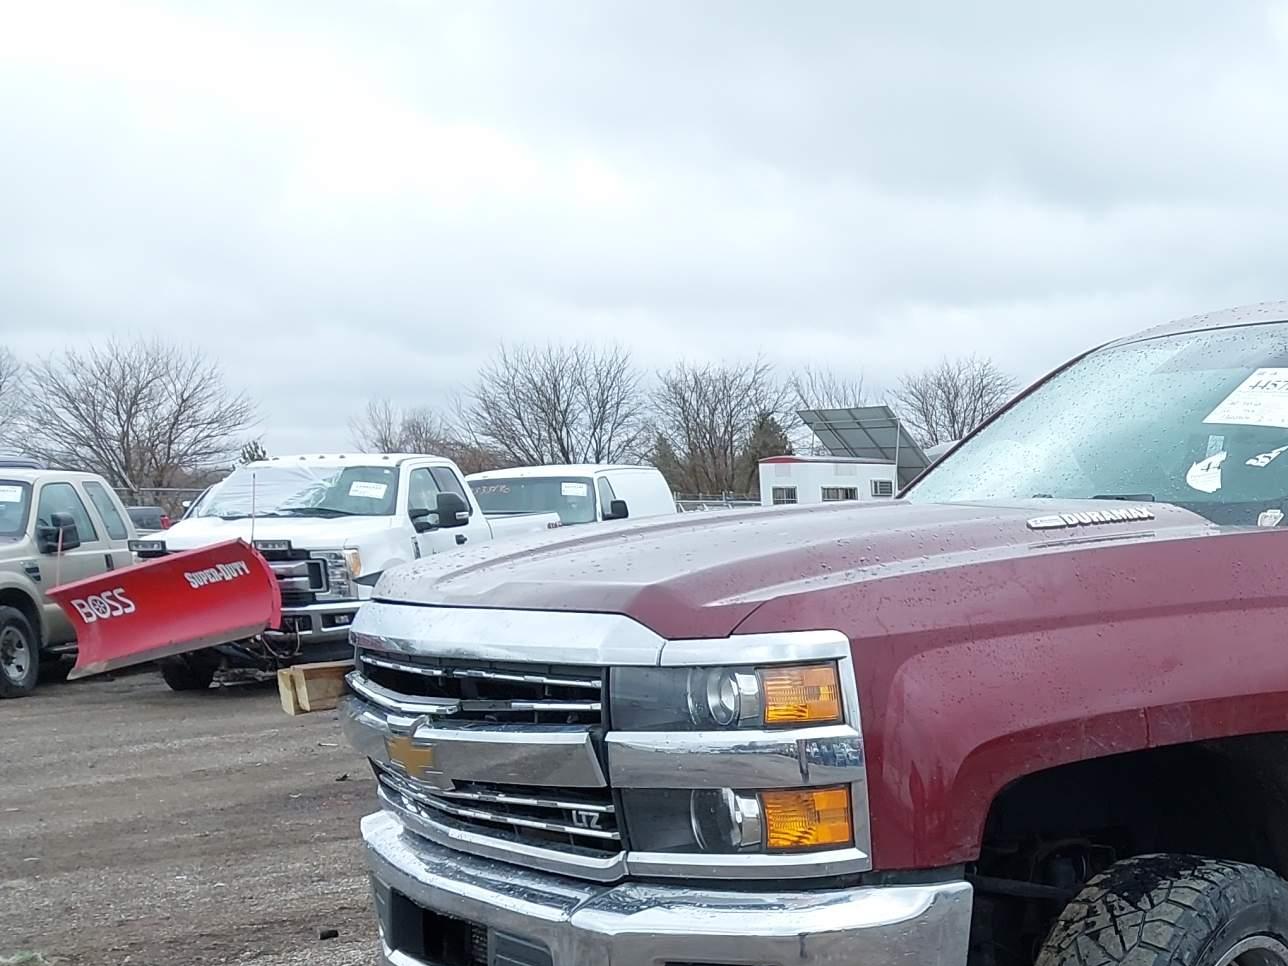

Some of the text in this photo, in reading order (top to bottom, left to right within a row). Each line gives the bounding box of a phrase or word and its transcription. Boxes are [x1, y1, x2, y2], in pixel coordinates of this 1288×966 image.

[1060, 507, 1155, 528] DURAMAX
[71, 588, 136, 624] BOSS
[572, 810, 602, 829] LTZ
